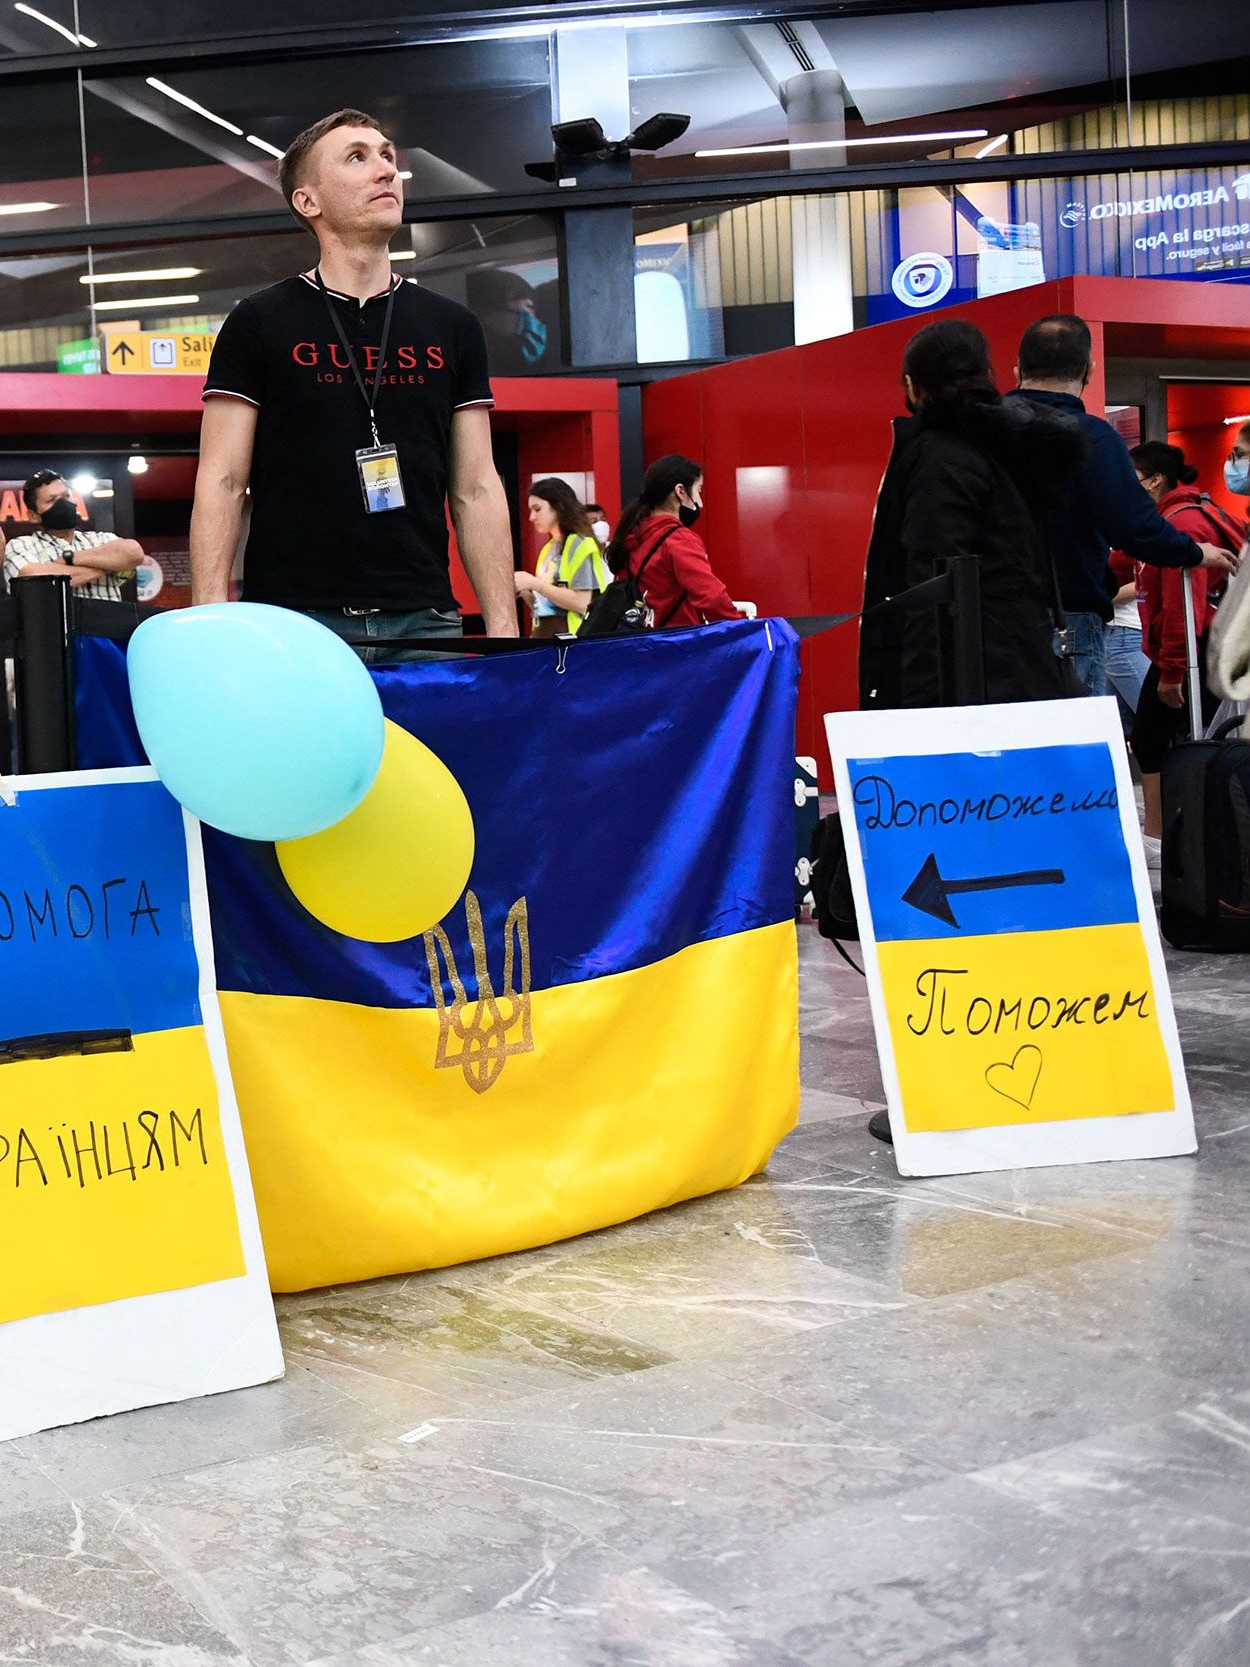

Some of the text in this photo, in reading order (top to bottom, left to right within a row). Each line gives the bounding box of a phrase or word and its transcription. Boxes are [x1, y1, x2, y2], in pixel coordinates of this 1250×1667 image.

[183, 359, 202, 367] Exit
[292, 342, 444, 370] GUESS
[317, 373, 343, 384] LOS
[907, 968, 1151, 1036] Поможем
